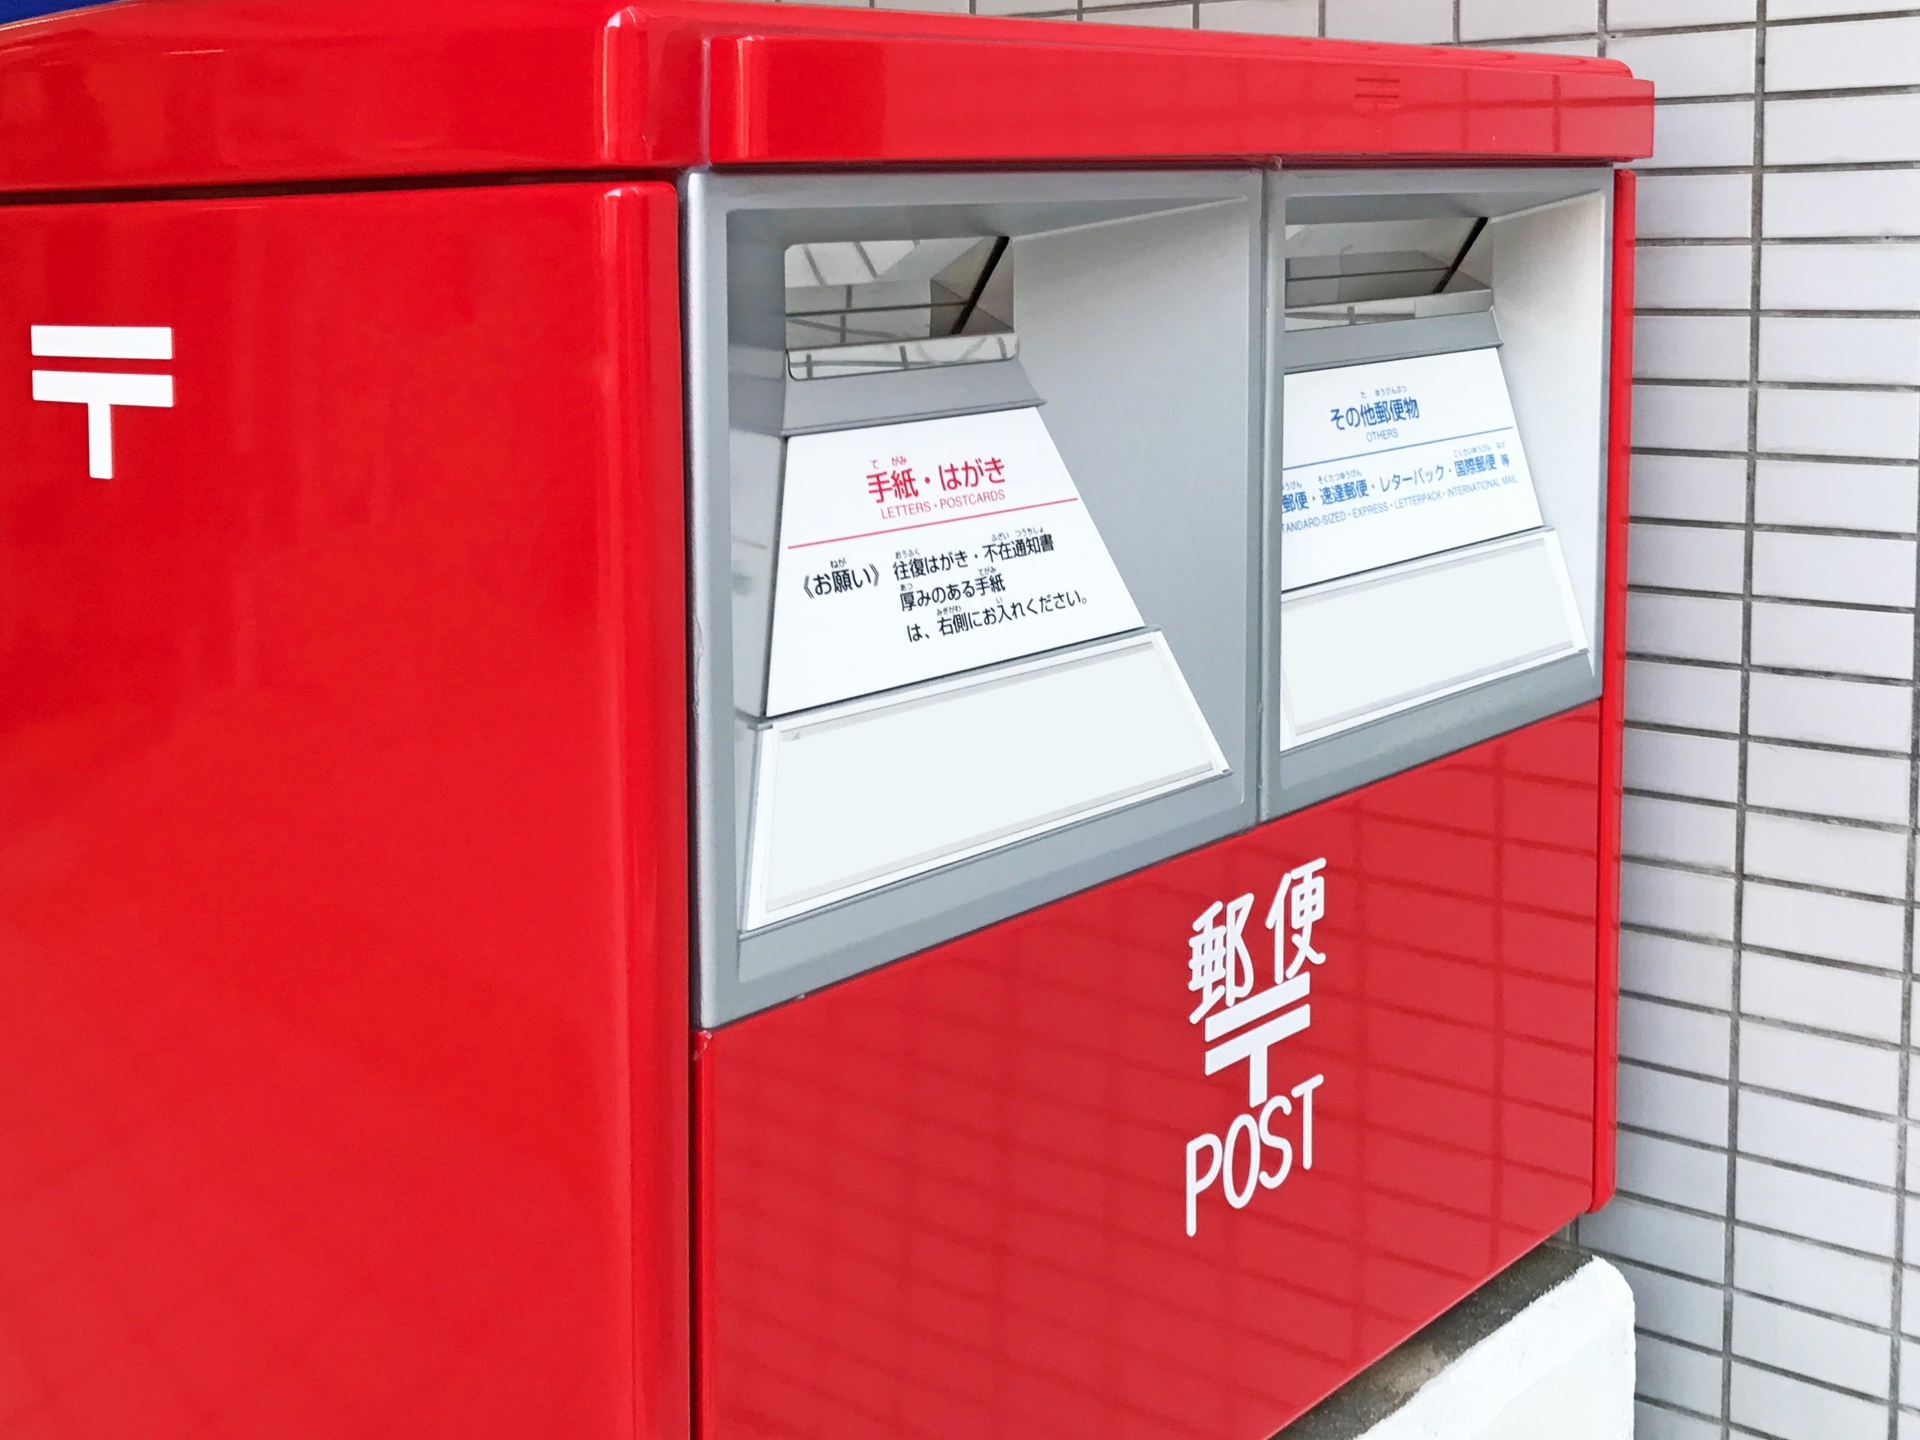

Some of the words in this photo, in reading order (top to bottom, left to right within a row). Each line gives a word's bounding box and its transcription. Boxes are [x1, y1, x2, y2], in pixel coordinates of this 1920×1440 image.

[1330, 396, 1420, 430] その他郵便物
[1366, 428, 1398, 442] OTHERS
[866, 456, 1006, 504] 手紙・はがき
[870, 459, 879, 469] て
[891, 455, 907, 467] がみ
[1501, 474, 1518, 485] MAIL
[803, 563, 879, 599] 《お願い》
[892, 533, 1054, 581] 往復はがき・不在通知書
[830, 557, 847, 569] ねが
[900, 573, 1006, 612] 厚みのある手紙
[907, 590, 1087, 643] は、右側にお入れください。
[1188, 858, 1327, 1025] 郵便
[1185, 1073, 1324, 1238] POST
